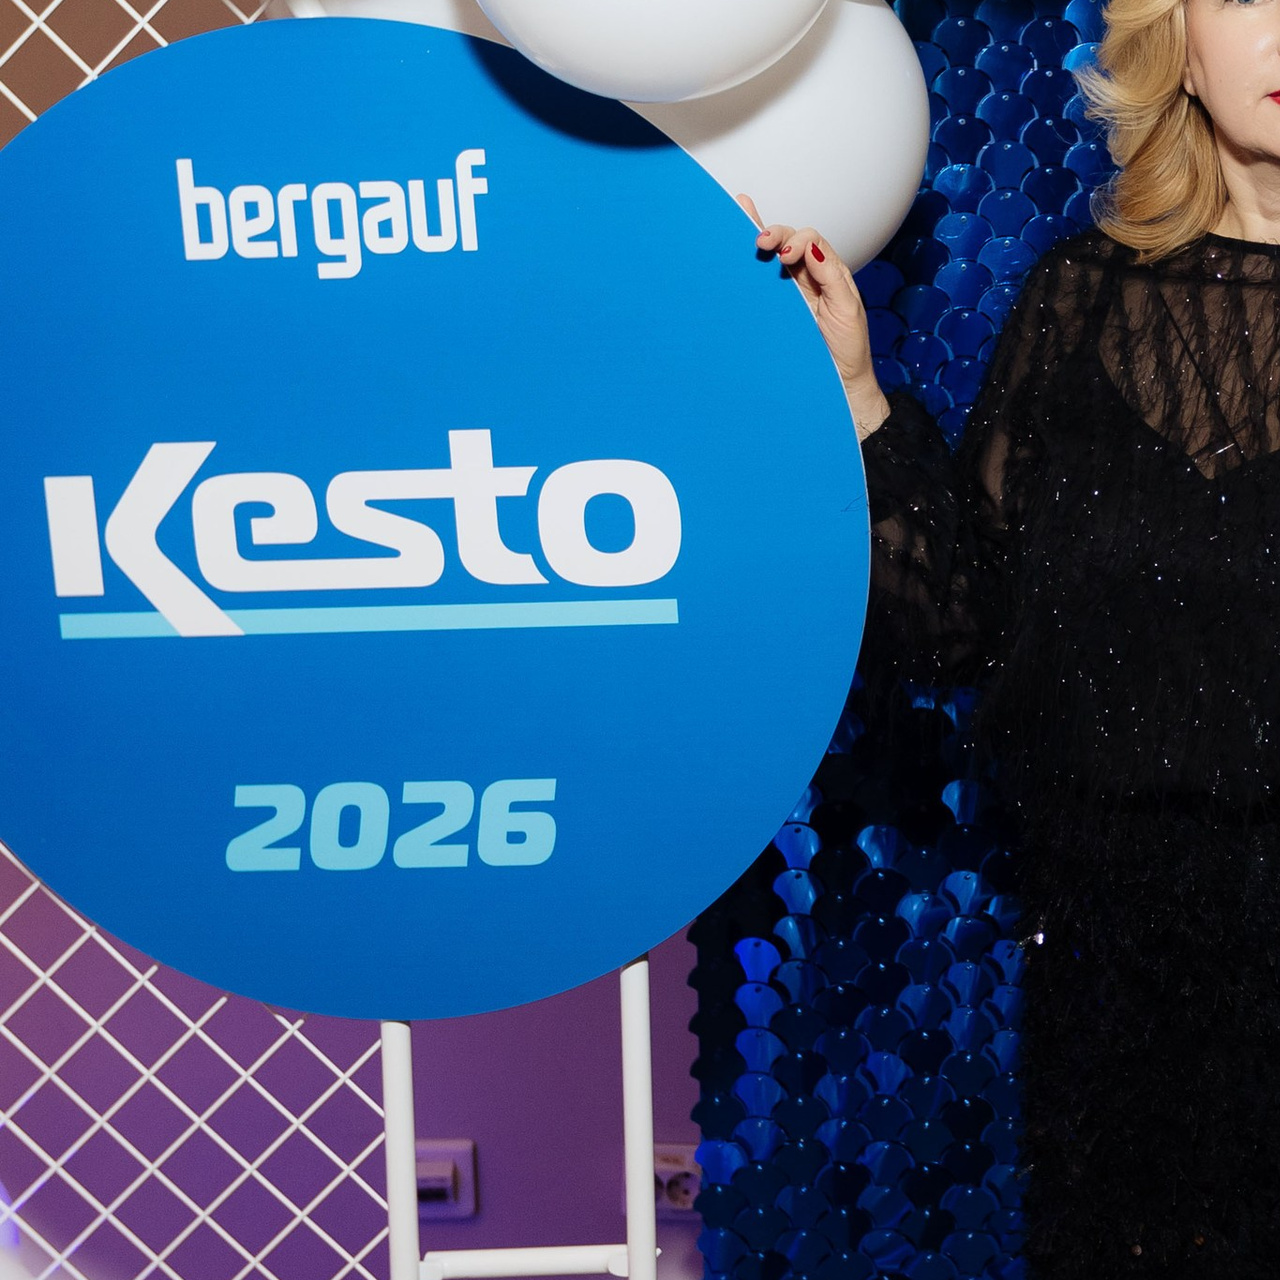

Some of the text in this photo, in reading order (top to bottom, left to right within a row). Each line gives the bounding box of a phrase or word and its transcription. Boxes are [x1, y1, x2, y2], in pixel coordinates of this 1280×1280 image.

[176, 148, 488, 280] bergauf
[44, 429, 682, 637] Kesto
[226, 779, 556, 871] 2026
